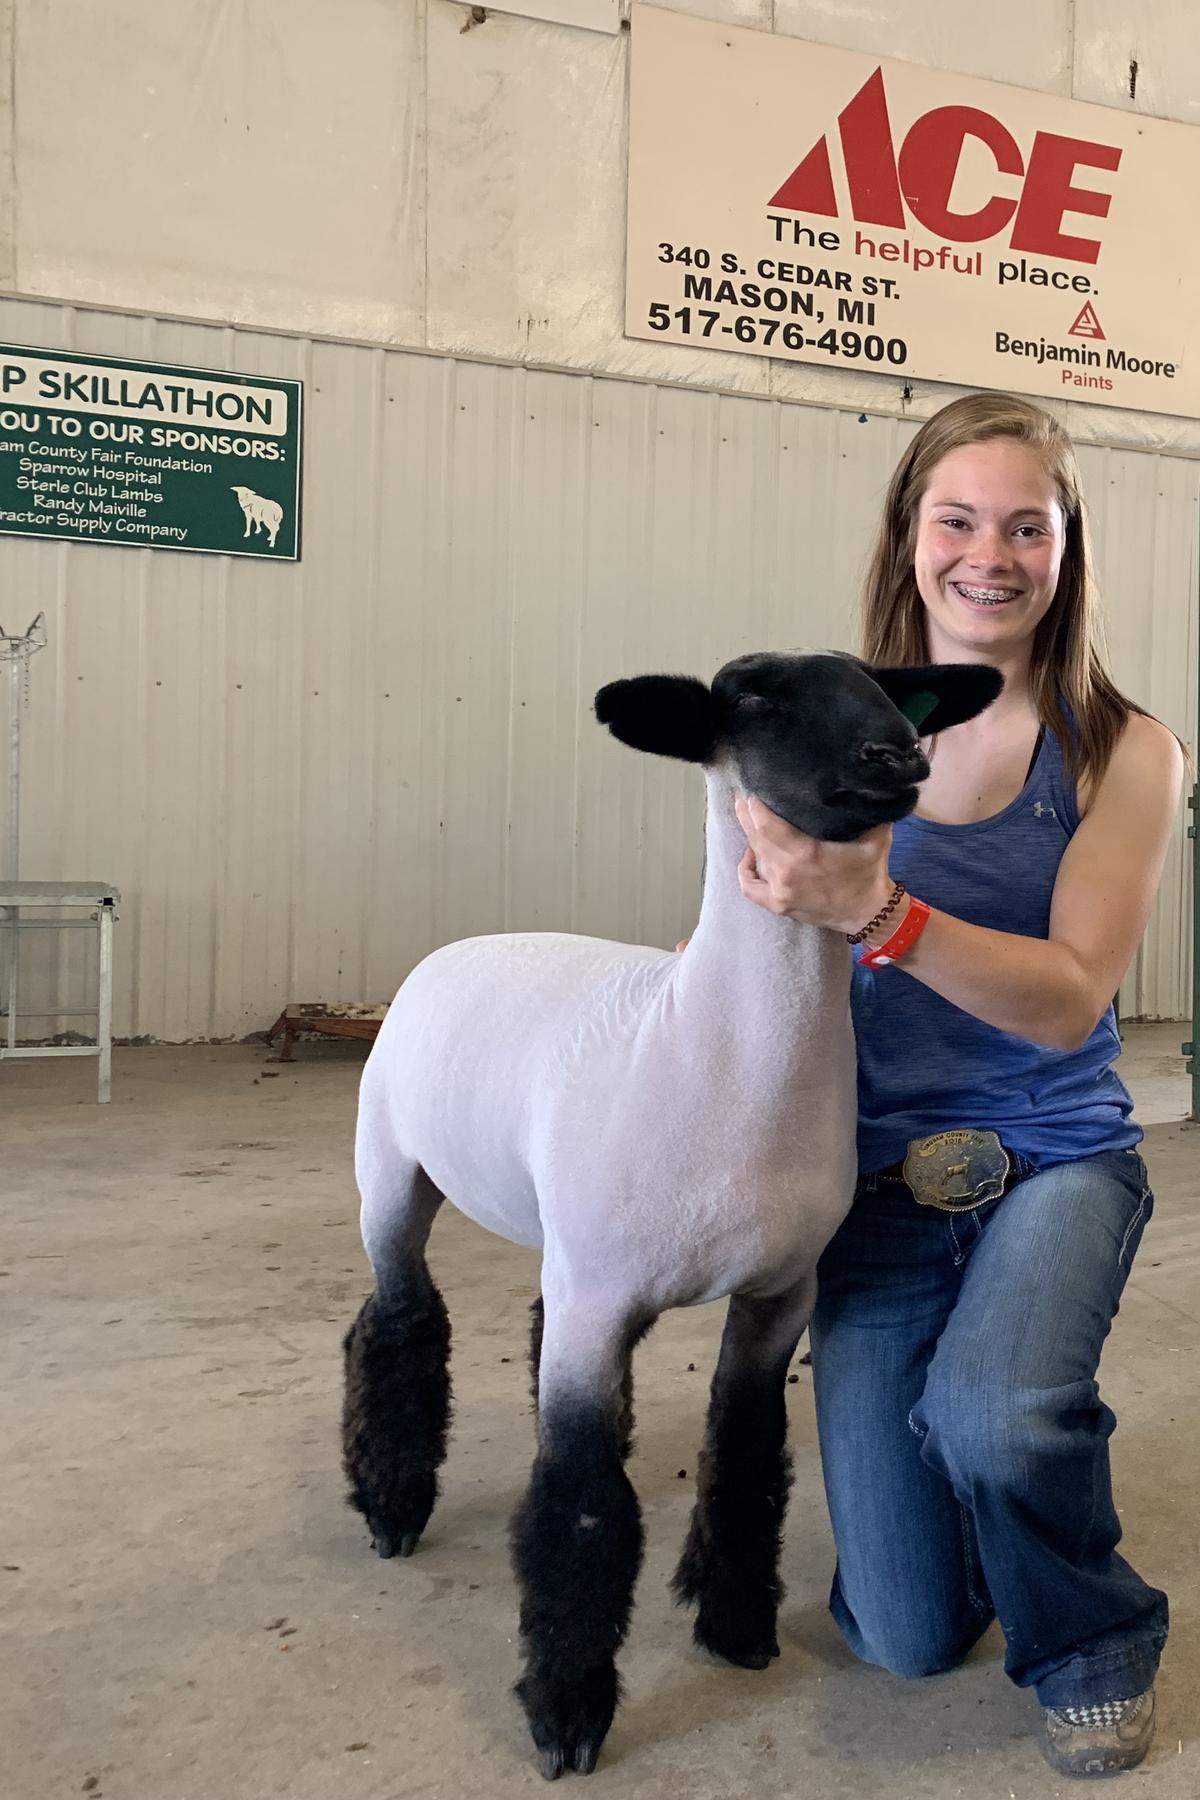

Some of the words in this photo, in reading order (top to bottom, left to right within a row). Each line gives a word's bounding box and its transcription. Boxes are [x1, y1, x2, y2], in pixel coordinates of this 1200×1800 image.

[766, 65, 1122, 265] ACE
[658, 243, 710, 269] 340
[720, 252, 747, 275] S.
[757, 259, 852, 292] CEDAR
[862, 276, 900, 300] ST.
[766, 215, 840, 251] The
[855, 231, 982, 276] helpful
[998, 259, 1099, 295] place.
[683, 274, 825, 323] MASON,
[838, 300, 875, 326] MI
[647, 303, 907, 365] 517-676-4900
[995, 332, 1100, 367] Benjamin
[1106, 349, 1175, 378] Moore
[39, 370, 272, 425] SKILLATHON
[1062, 369, 1113, 391] Paints
[0, 410, 40, 432] OU
[47, 415, 81, 437] TO
[89, 421, 144, 444] OUR
[151, 428, 285, 461] SPONSORS:
[28, 441, 87, 462] County
[91, 448, 121, 463] Fair
[125, 452, 212, 473] Foundation
[17, 476, 70, 493] Sterle
[73, 482, 107, 497] Club
[111, 486, 163, 503] Lambs
[19, 458, 89, 476] Sparrow
[93, 466, 161, 486] Hospital
[0, 509, 53, 525] ractor
[57, 514, 112, 533] Supply
[116, 519, 188, 540] Company
[33, 494, 85, 515] Randy
[89, 500, 147, 518] Maiville
